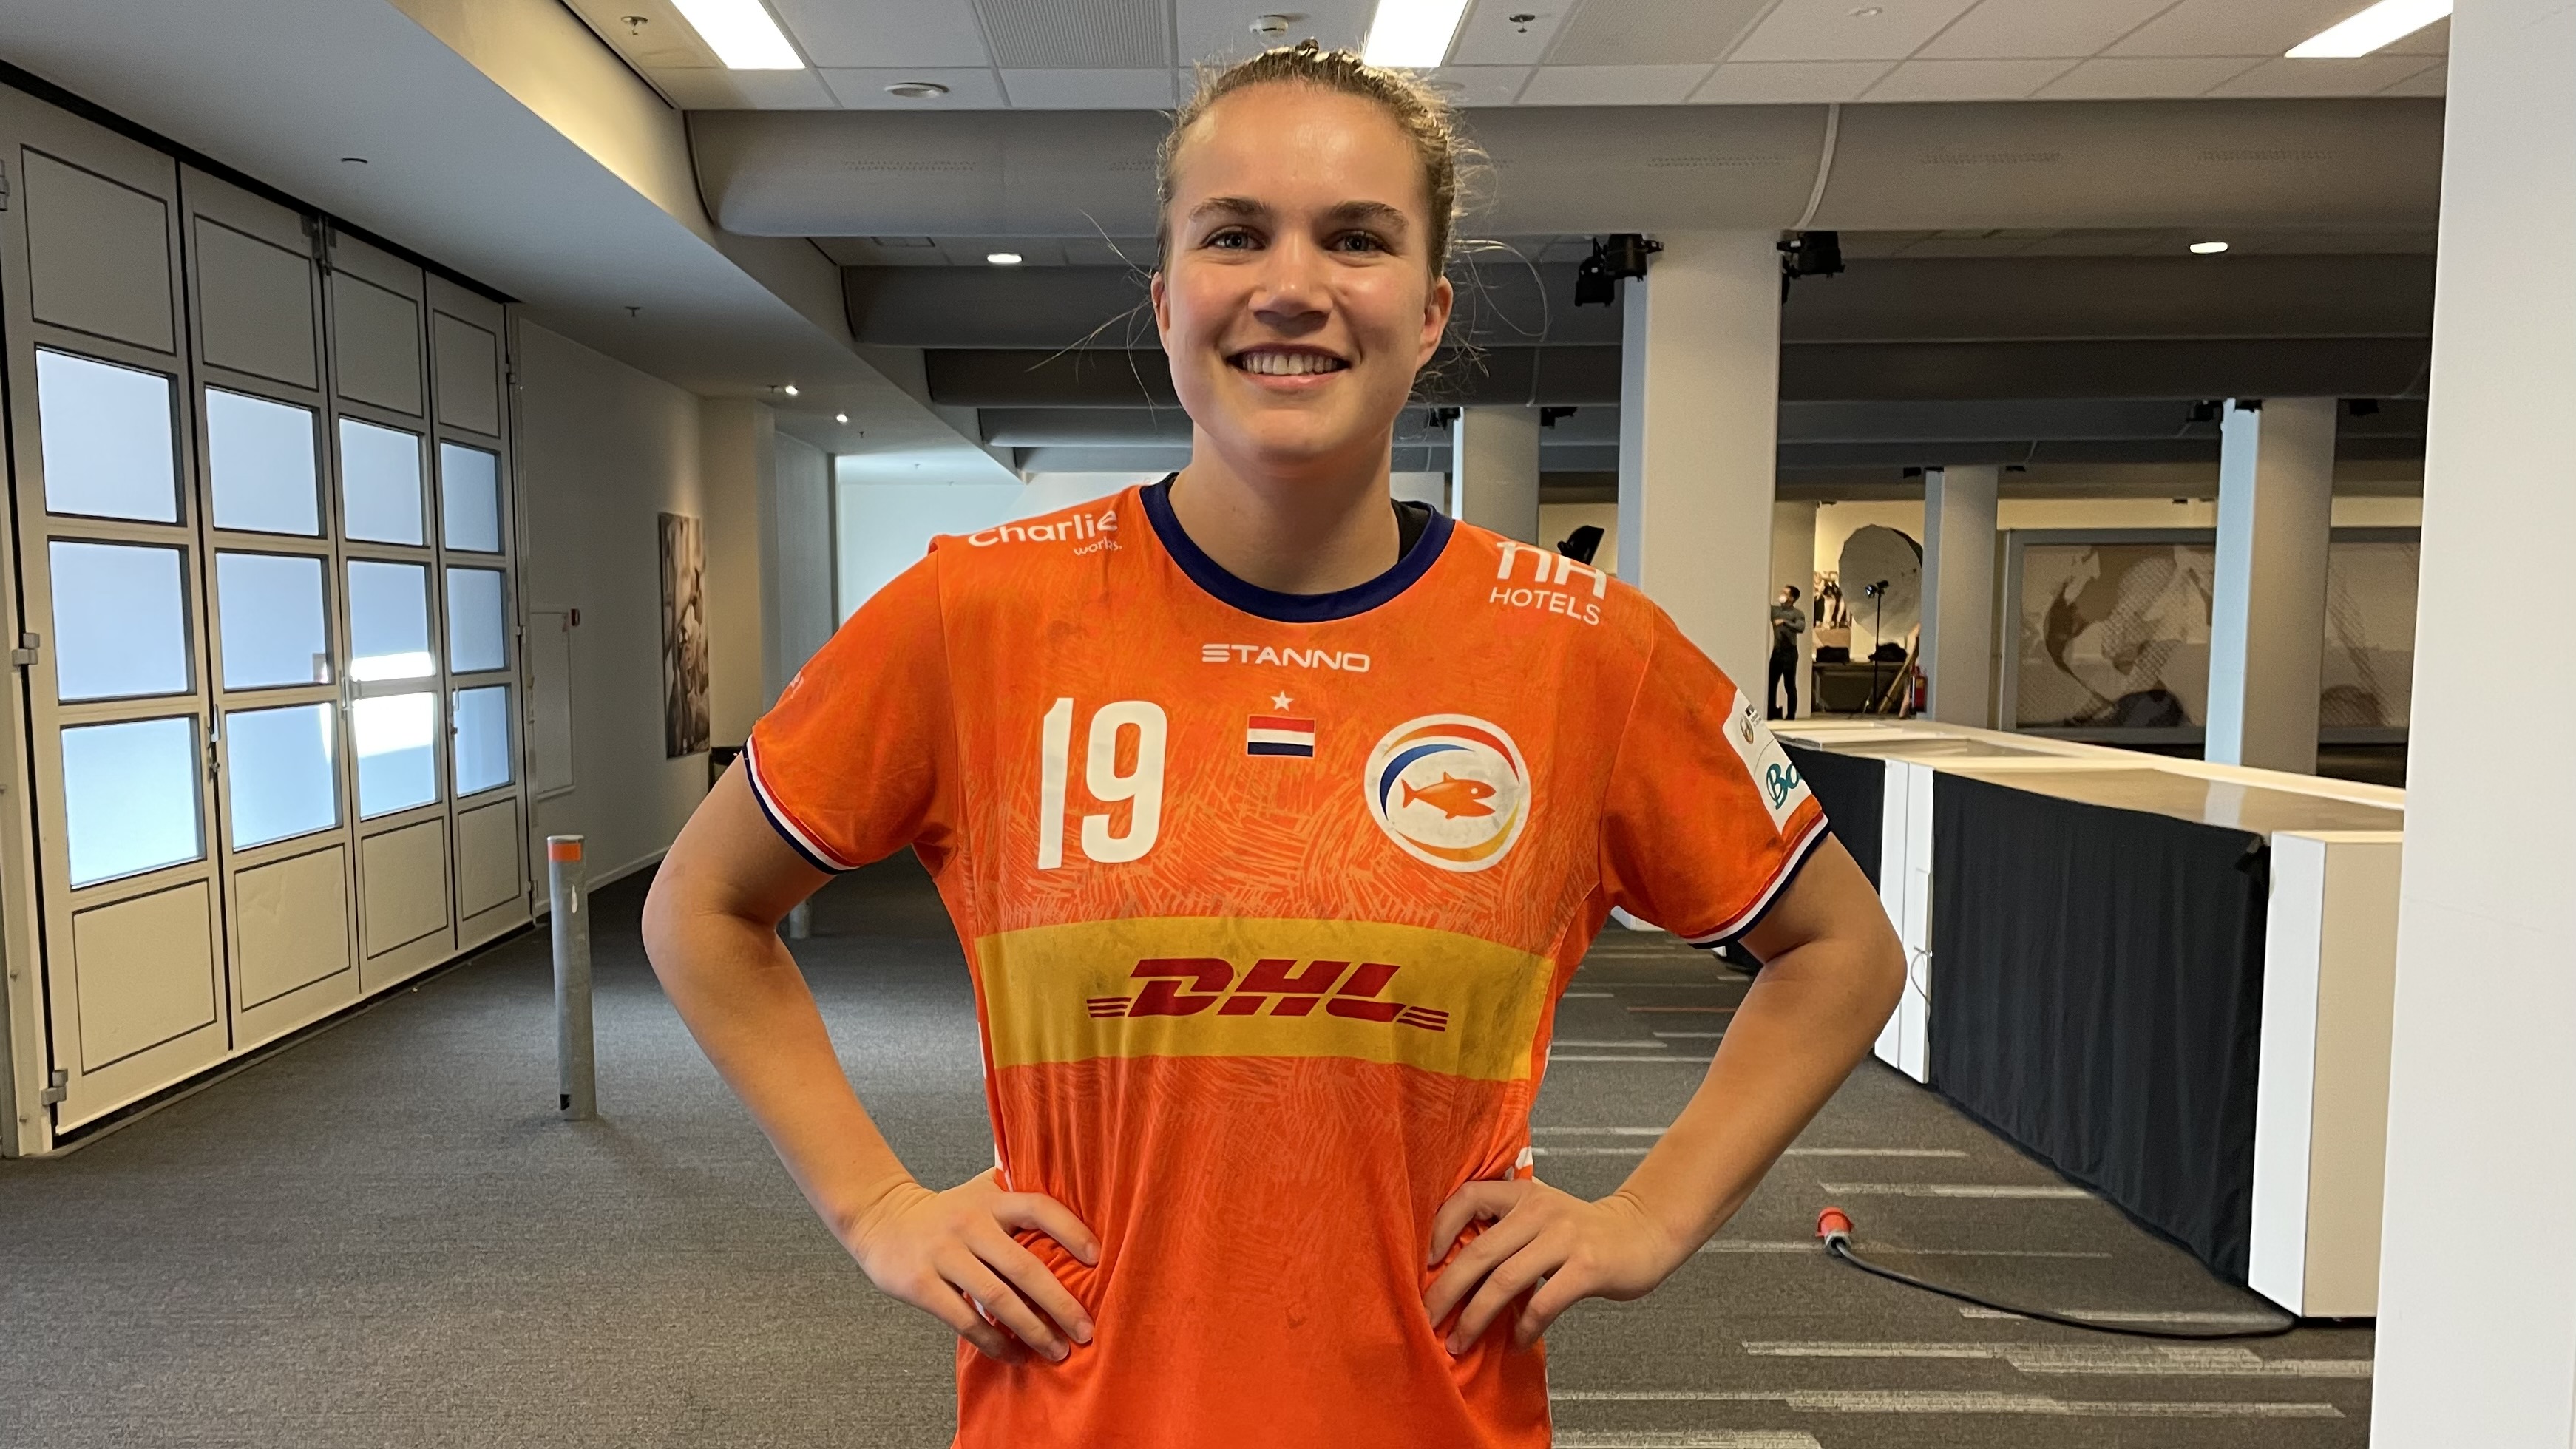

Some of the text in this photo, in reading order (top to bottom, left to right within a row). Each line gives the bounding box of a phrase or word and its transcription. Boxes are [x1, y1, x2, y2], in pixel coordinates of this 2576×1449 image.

[1073, 536, 1123, 556] works.
[1488, 586, 1601, 626] HOTELS
[1201, 643, 1371, 673] STANNO
[1037, 697, 1167, 869] 19
[1127, 957, 1402, 1023] DHL
